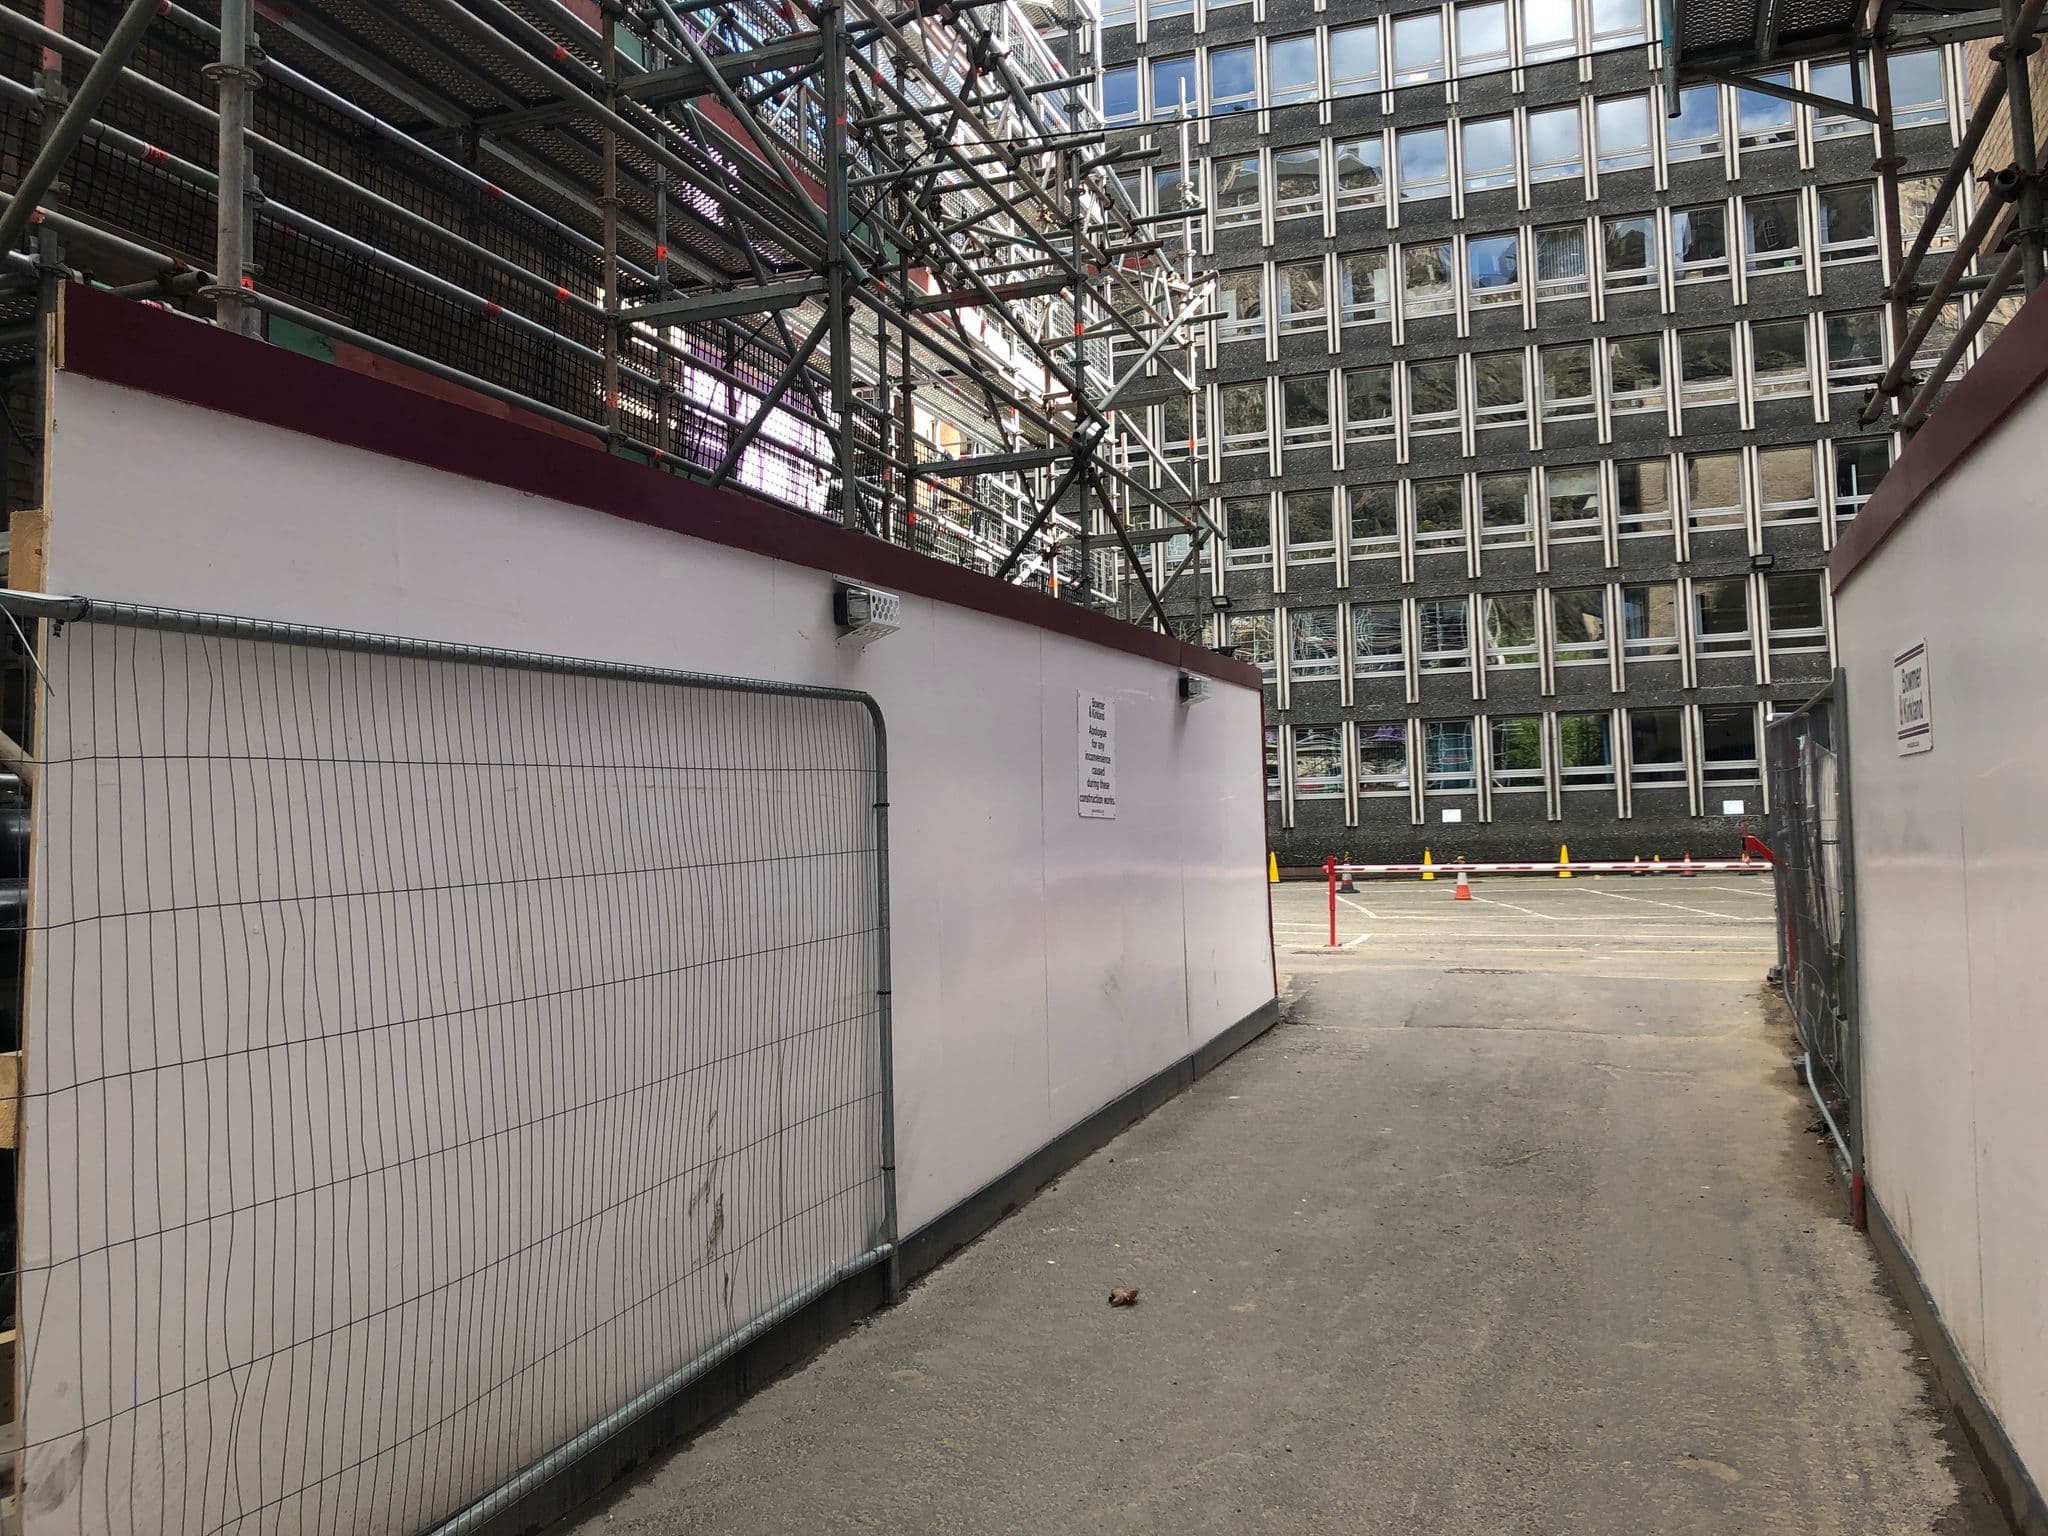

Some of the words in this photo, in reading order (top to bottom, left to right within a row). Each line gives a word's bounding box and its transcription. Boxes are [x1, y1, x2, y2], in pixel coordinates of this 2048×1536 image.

[1097, 742, 1105, 752] any
[1085, 752, 1111, 764] inconvenience
[1092, 767, 1105, 776] caused
[1087, 779, 1099, 790] during
[1099, 779, 1110, 790] these
[1080, 794, 1103, 804] construction
